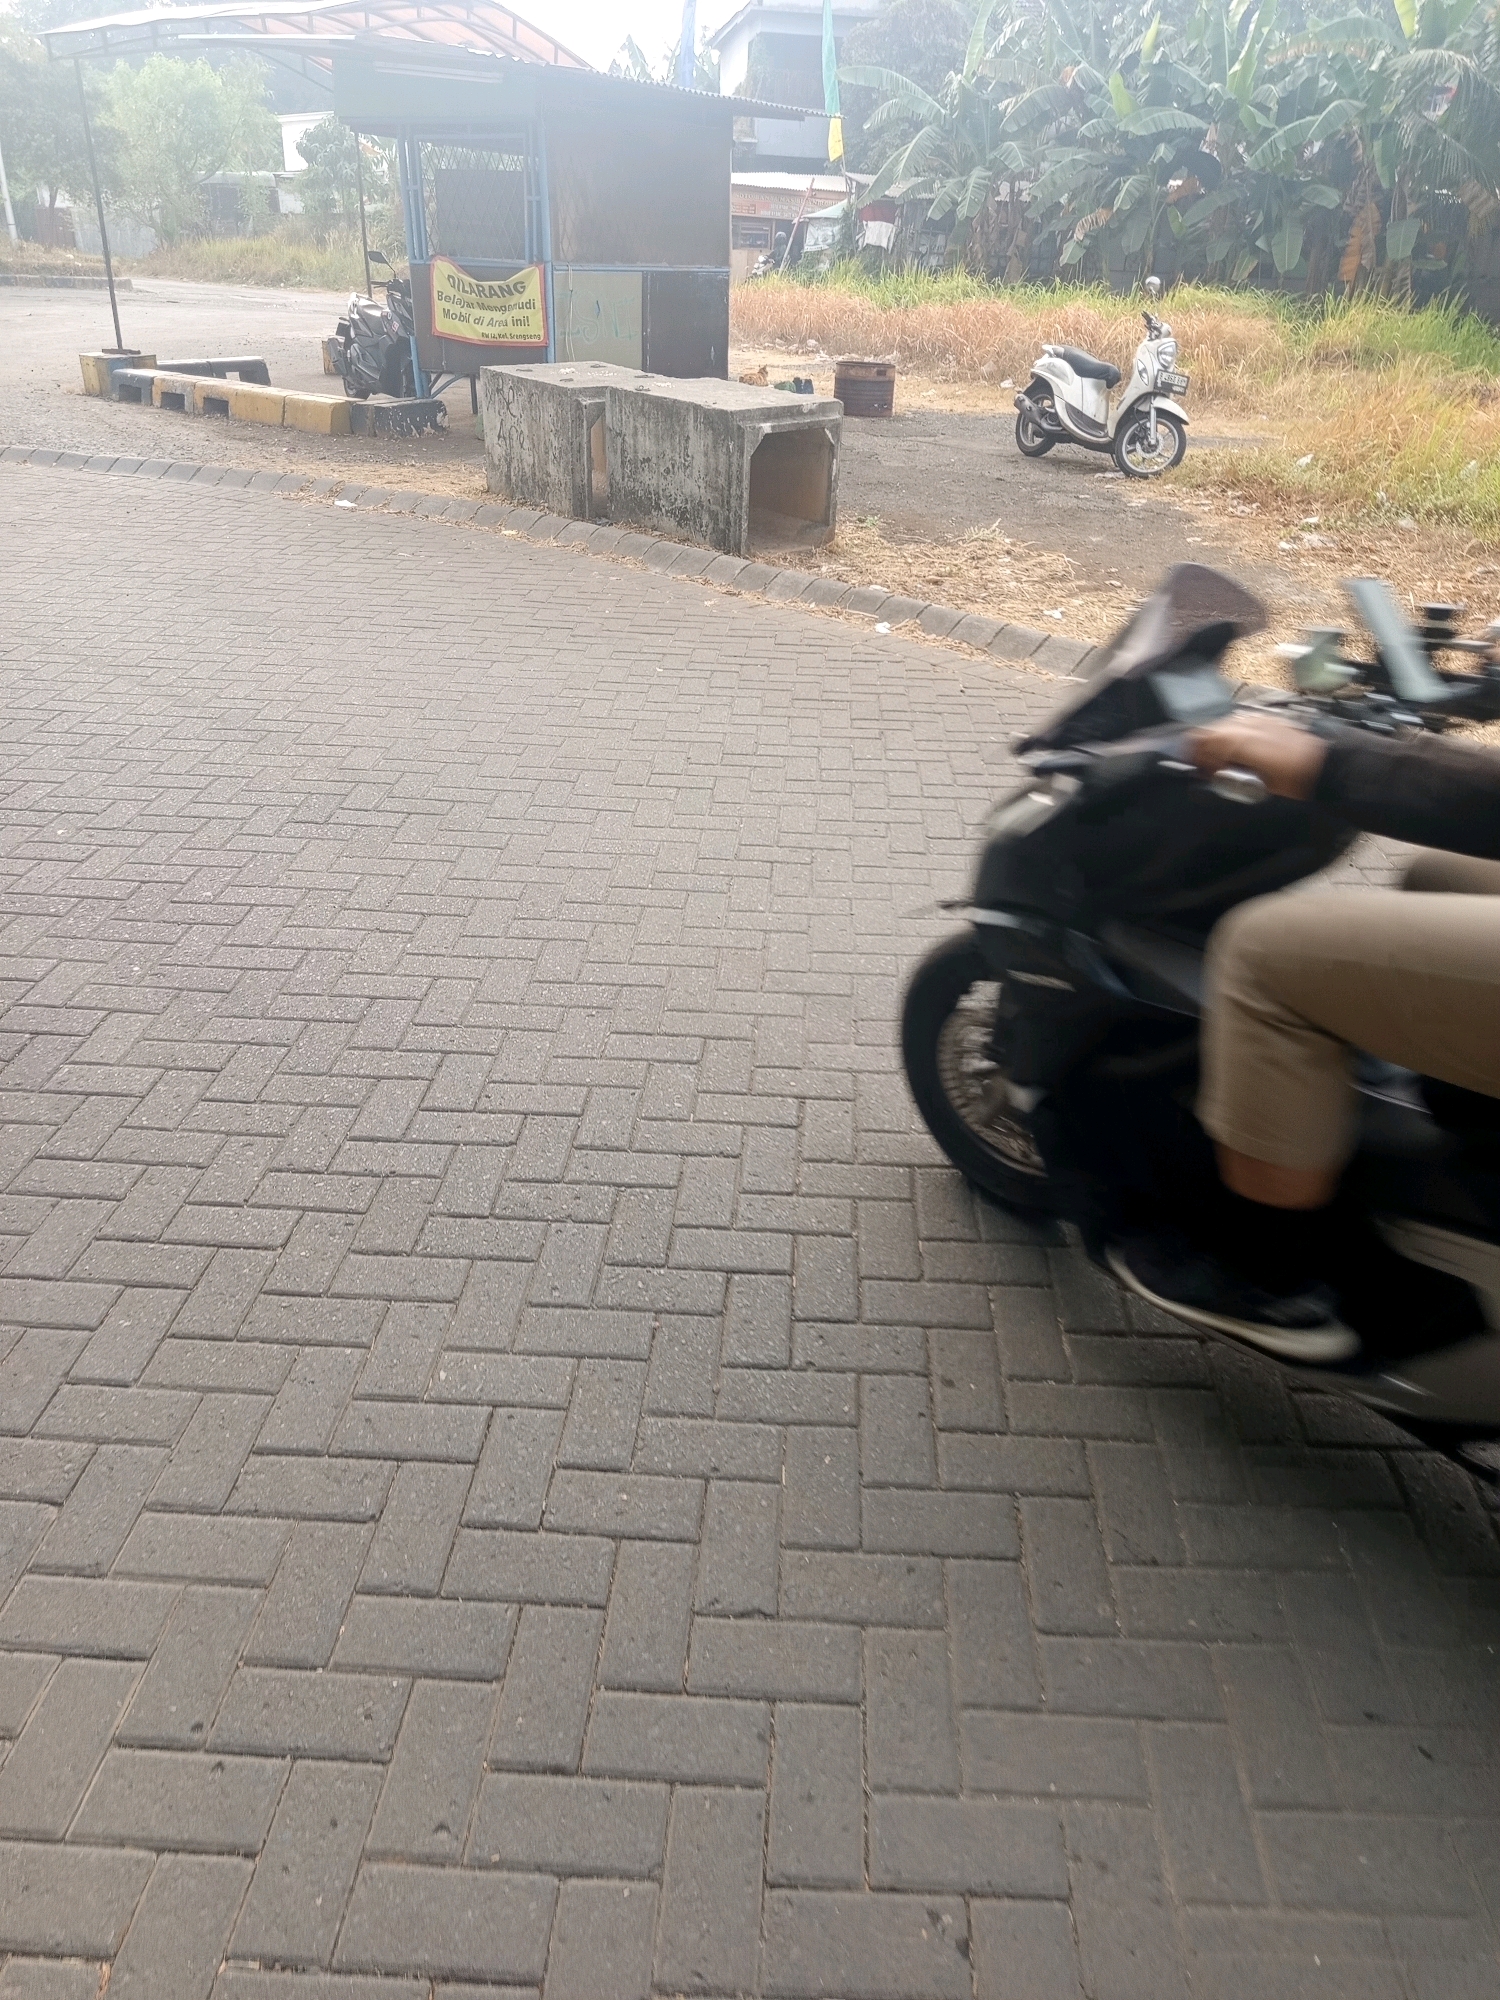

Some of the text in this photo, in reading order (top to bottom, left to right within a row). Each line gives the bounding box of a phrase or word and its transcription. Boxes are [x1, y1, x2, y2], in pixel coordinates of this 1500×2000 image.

[447, 274, 526, 299] DILARANG
[437, 290, 475, 308] Belajar
[442, 308, 530, 327] Mobil di Area ini!
[509, 332, 541, 341] Srengseng
